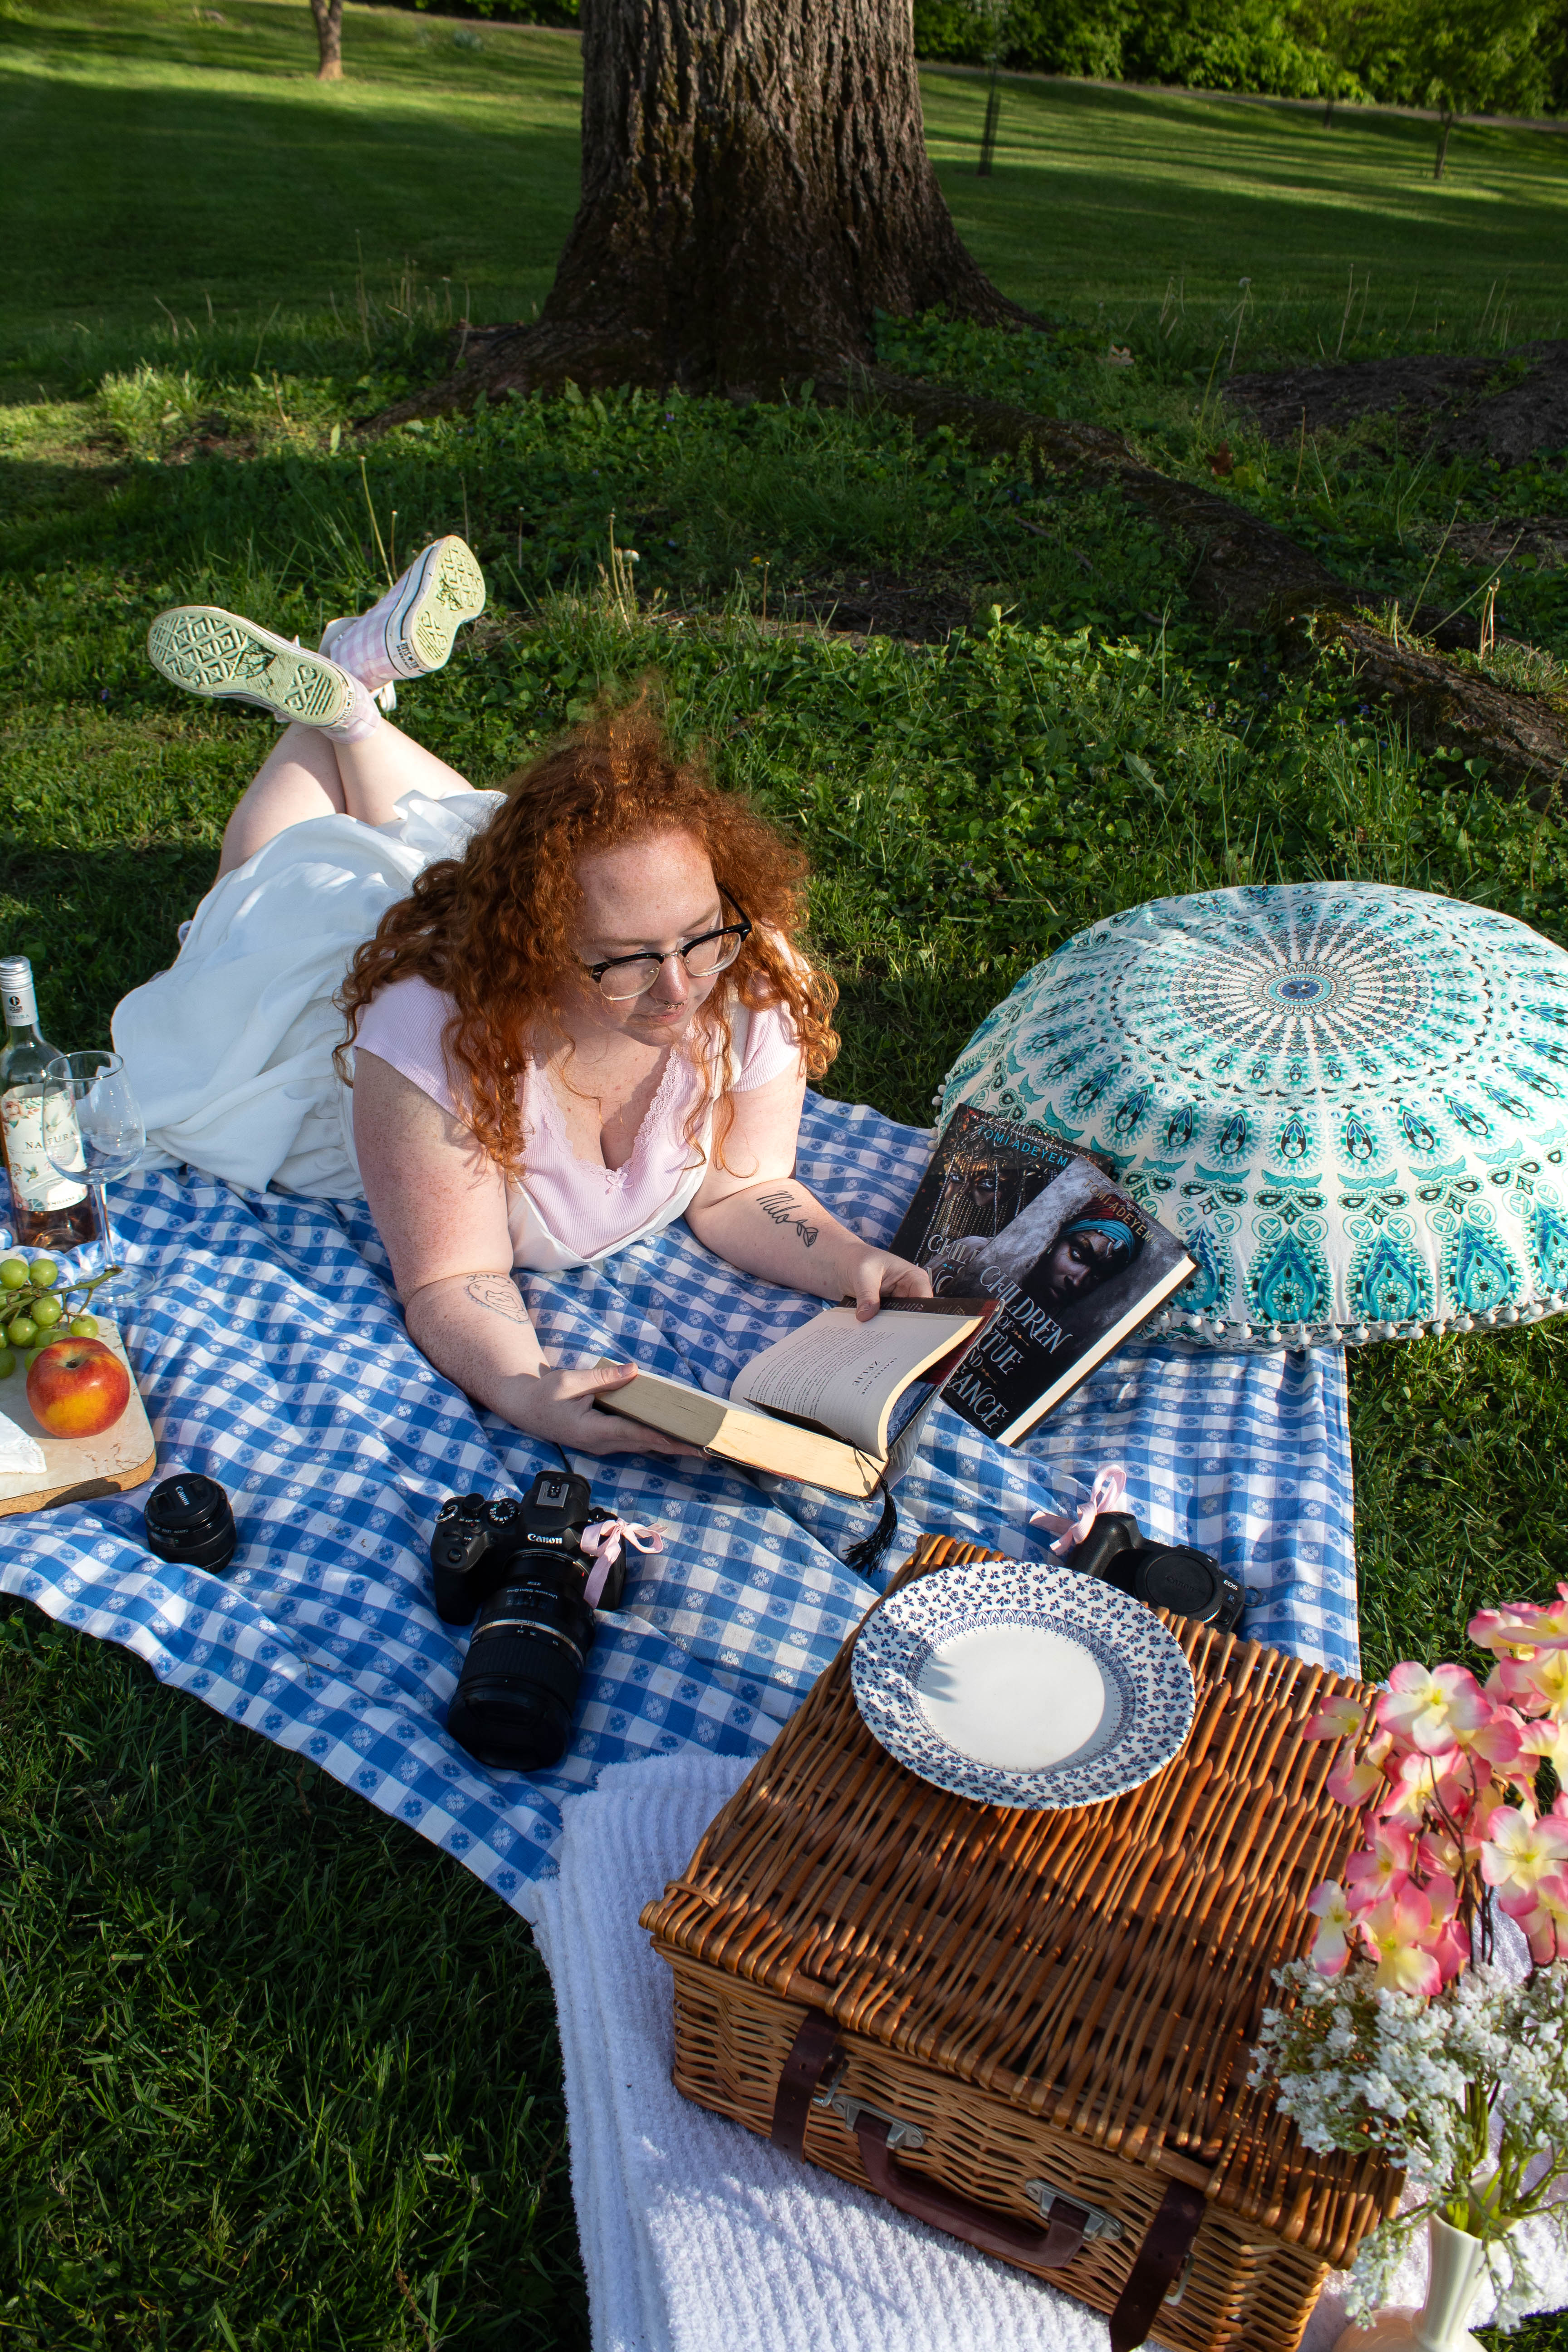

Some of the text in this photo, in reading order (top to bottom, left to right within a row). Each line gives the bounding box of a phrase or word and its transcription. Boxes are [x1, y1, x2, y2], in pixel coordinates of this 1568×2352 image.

[995, 1122, 1008, 1131] YORK
[977, 1126, 1073, 1167] TOMI ADEYEM
[756, 1190, 802, 1224] Milo
[1084, 1179, 1158, 1246] TOMI ADEYEMI
[1092, 1171, 1102, 1180] NEW
[1103, 1179, 1113, 1191] YORK
[1153, 1225, 1171, 1242] AUTHOR
[980, 1266, 1073, 1354] CHILDREN
[997, 1315, 1015, 1331] OF
[977, 1328, 1024, 1375] TUE
[861, 1381, 872, 1394] NINE
[175, 1486, 190, 1506] Canon
[527, 1533, 563, 1544] Canon
[1224, 1579, 1238, 1590] EOS
[1228, 1594, 1235, 1602] R
